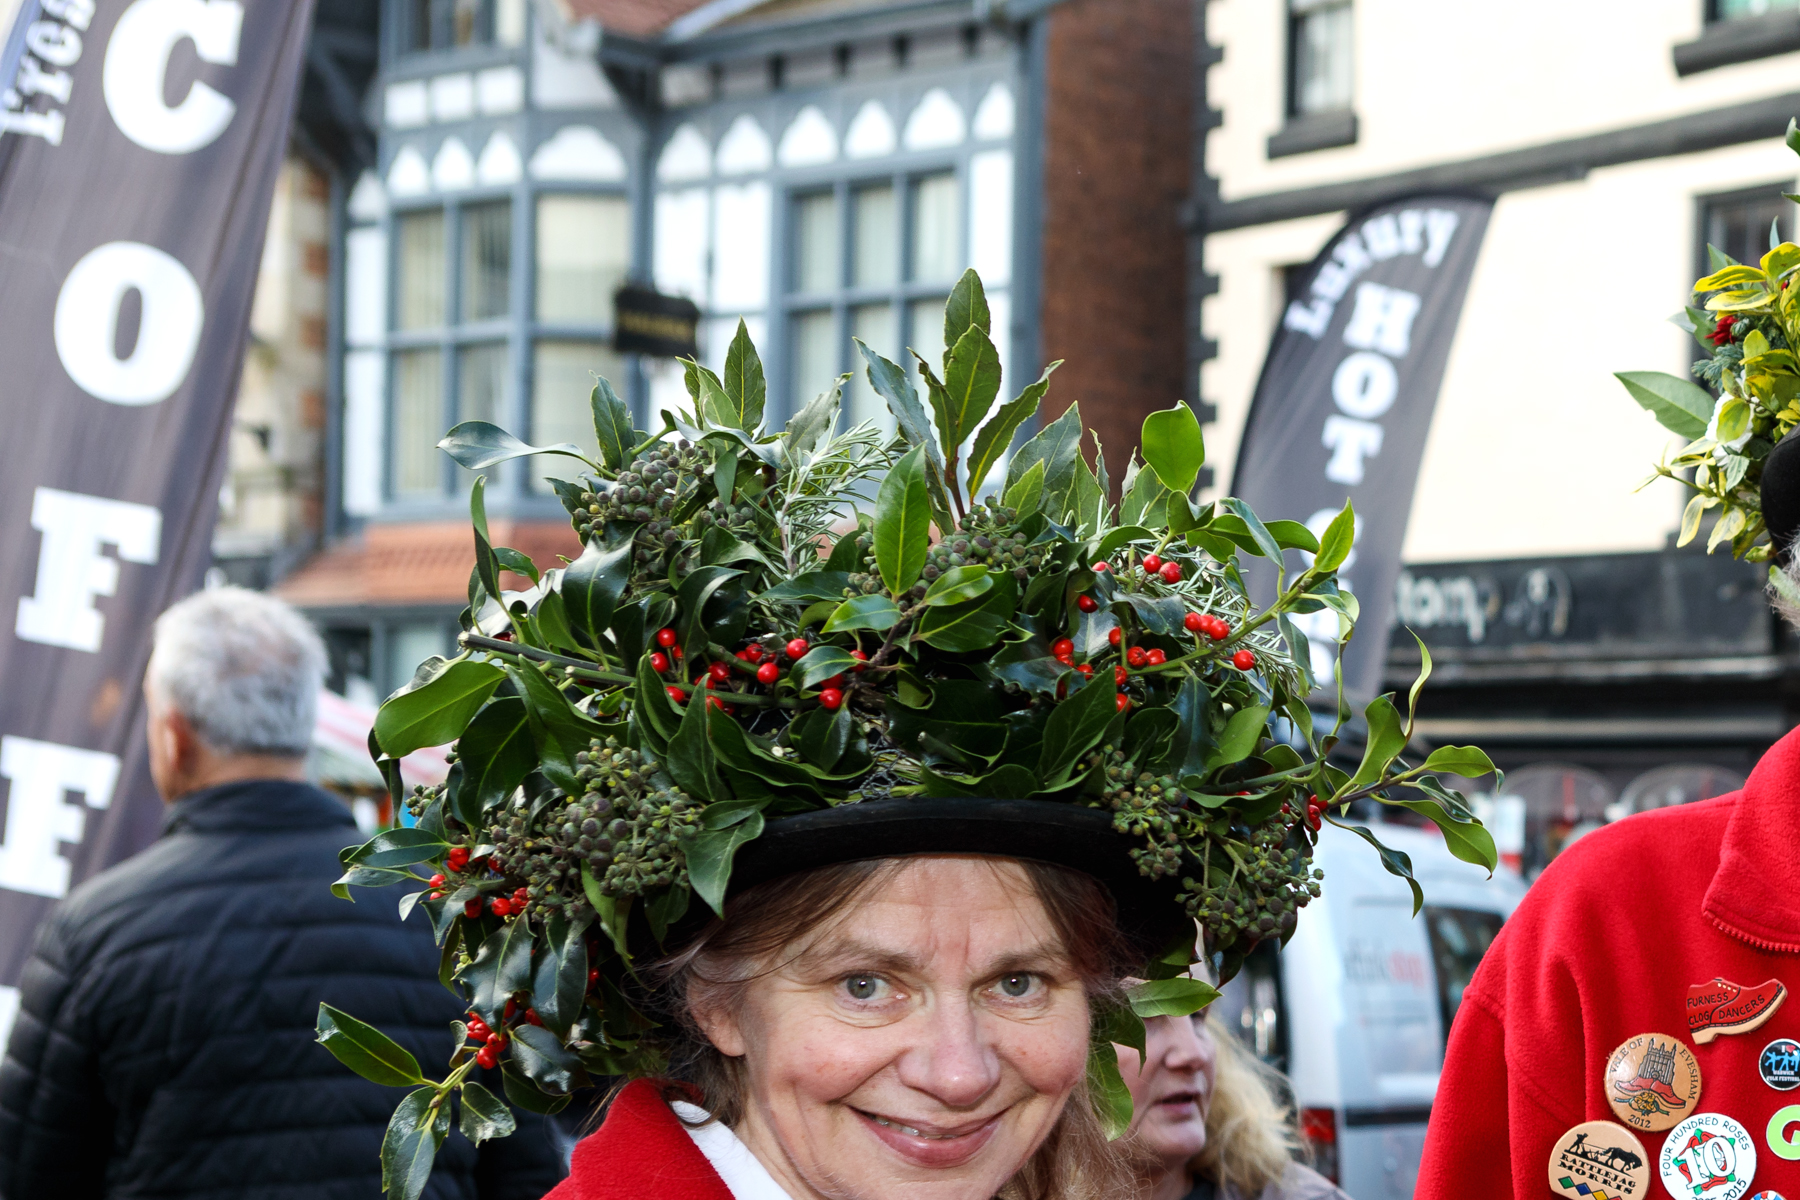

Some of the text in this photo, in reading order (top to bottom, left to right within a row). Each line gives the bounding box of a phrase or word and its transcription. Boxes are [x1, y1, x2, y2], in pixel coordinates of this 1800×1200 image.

[1284, 207, 1459, 341] Luxury
[1321, 280, 1422, 487] HOT
[1686, 991, 1729, 1009] FURNESS
[1688, 994, 1765, 1026] CLOG DANCERS
[1609, 1037, 1698, 1101] VALE OF EVESHAM
[1628, 1114, 1652, 1129] 2012
[1560, 1152, 1636, 1188] RATTLEJAG
[1662, 1117, 1750, 1177] FOUR HUNDRED ROSES
[1676, 1135, 1737, 1191] 10
[1557, 1160, 1634, 1195] MORRIS
